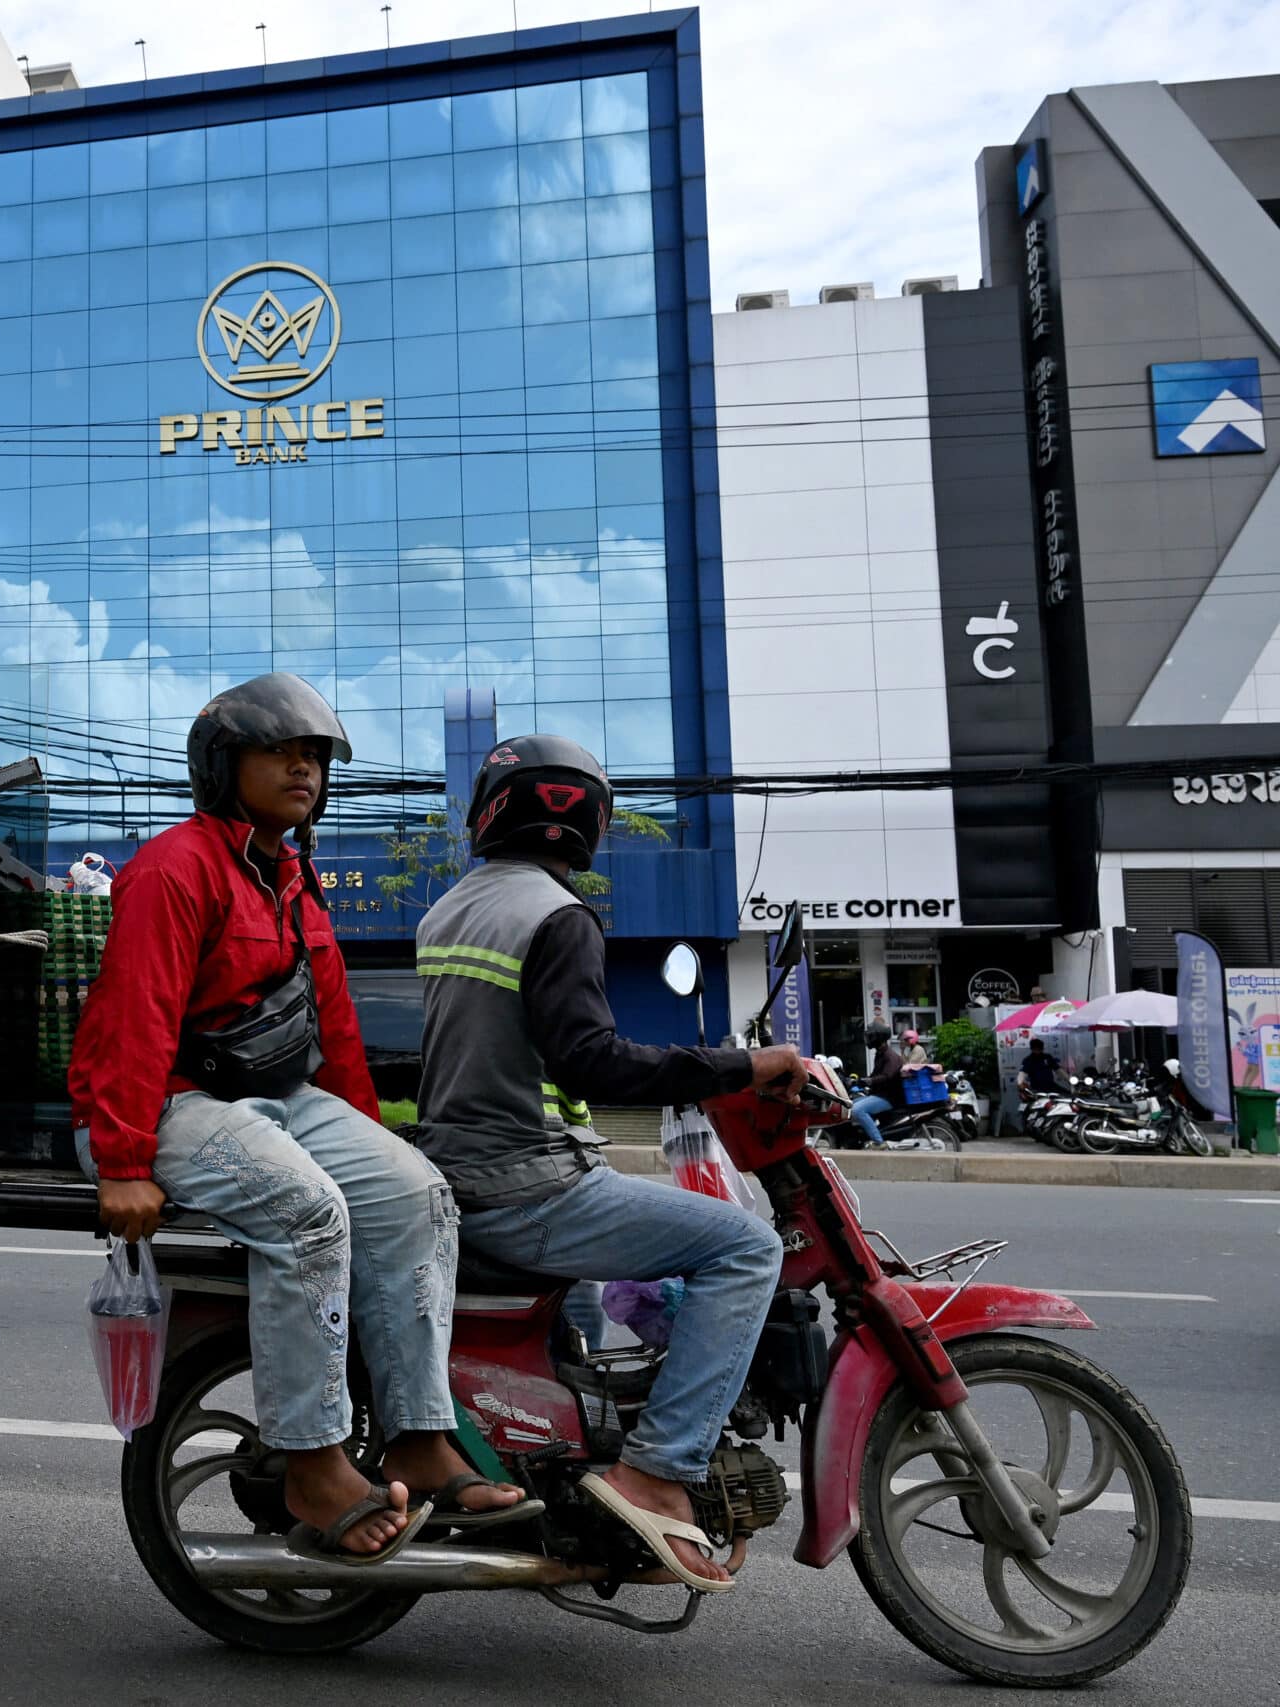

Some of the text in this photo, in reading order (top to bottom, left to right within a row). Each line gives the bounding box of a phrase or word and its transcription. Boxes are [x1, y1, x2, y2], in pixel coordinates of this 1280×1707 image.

[159, 398, 385, 455] PRINCE
[235, 445, 308, 465] BANK
[845, 899, 955, 917] corner
[1190, 951, 1211, 1089] COFFEE corner
